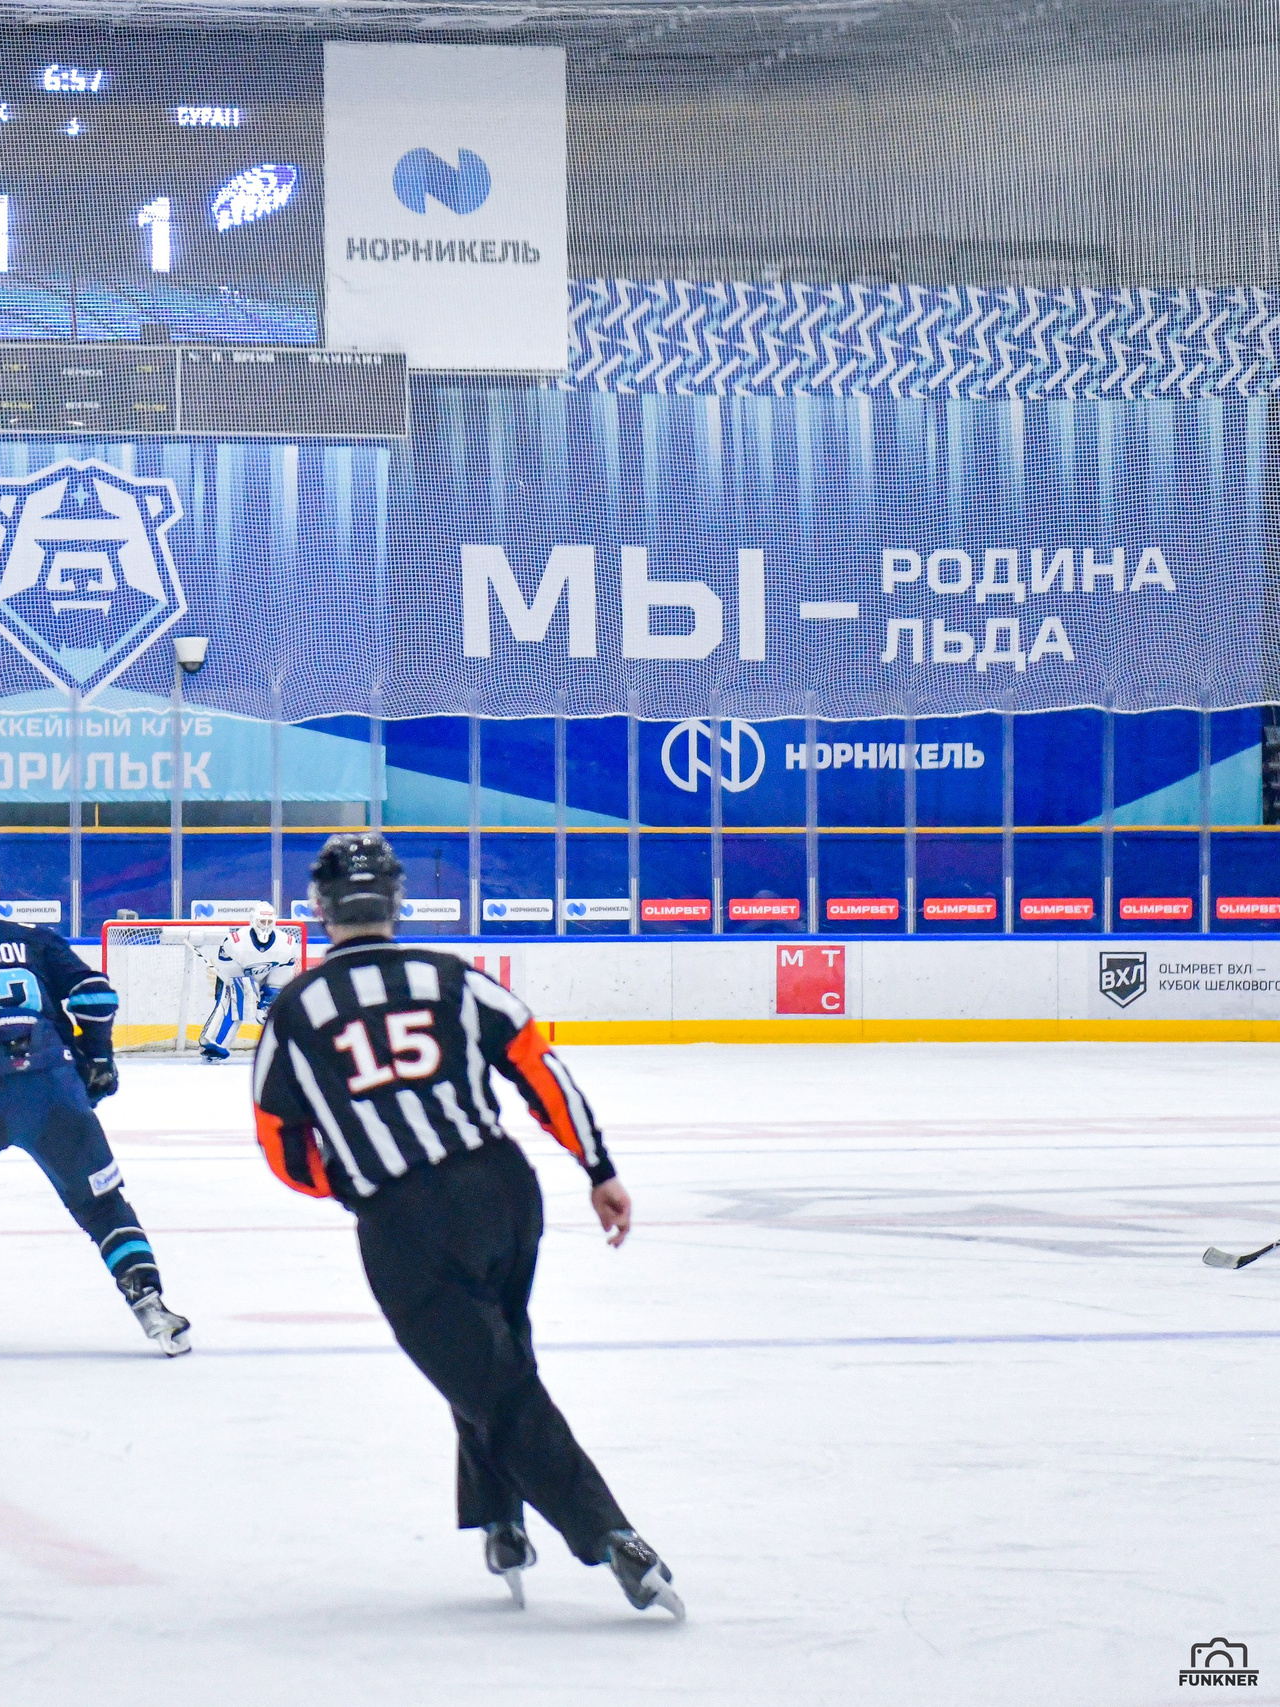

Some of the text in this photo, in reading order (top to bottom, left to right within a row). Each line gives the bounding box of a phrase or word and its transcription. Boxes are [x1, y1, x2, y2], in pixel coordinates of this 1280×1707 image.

[138, 197, 171, 273] 1
[346, 237, 541, 264] НОРНИКЕЛЬ
[882, 547, 1177, 603] РОДИНА
[460, 544, 765, 661] МЫ
[882, 617, 1075, 673] ЛЬДА
[785, 741, 986, 770] НОРНИКЕЛЬ
[217, 906, 254, 914] НОРНИКЕЛ
[509, 906, 550, 914] НОРНИКЕЛЬ
[589, 905, 629, 913] НОРНИКЕЛЬ
[644, 905, 708, 916] OLIMPBET
[732, 905, 797, 916] OLIMPBET
[829, 904, 896, 916] OLIMPBET
[926, 904, 993, 915] OLIMPBET
[1023, 904, 1091, 915] OLIMPBET
[1122, 904, 1189, 915] OLIMPBET
[1219, 903, 1280, 914] OLIMPBET
[1158, 963, 1223, 975] OLIMPBET
[1227, 963, 1252, 975] ВХЛ
[1101, 963, 1145, 990] ВХЛ
[1159, 980, 1280, 992] КУБОК ШЕЛКОВОГО
[334, 1009, 441, 1095] 15
